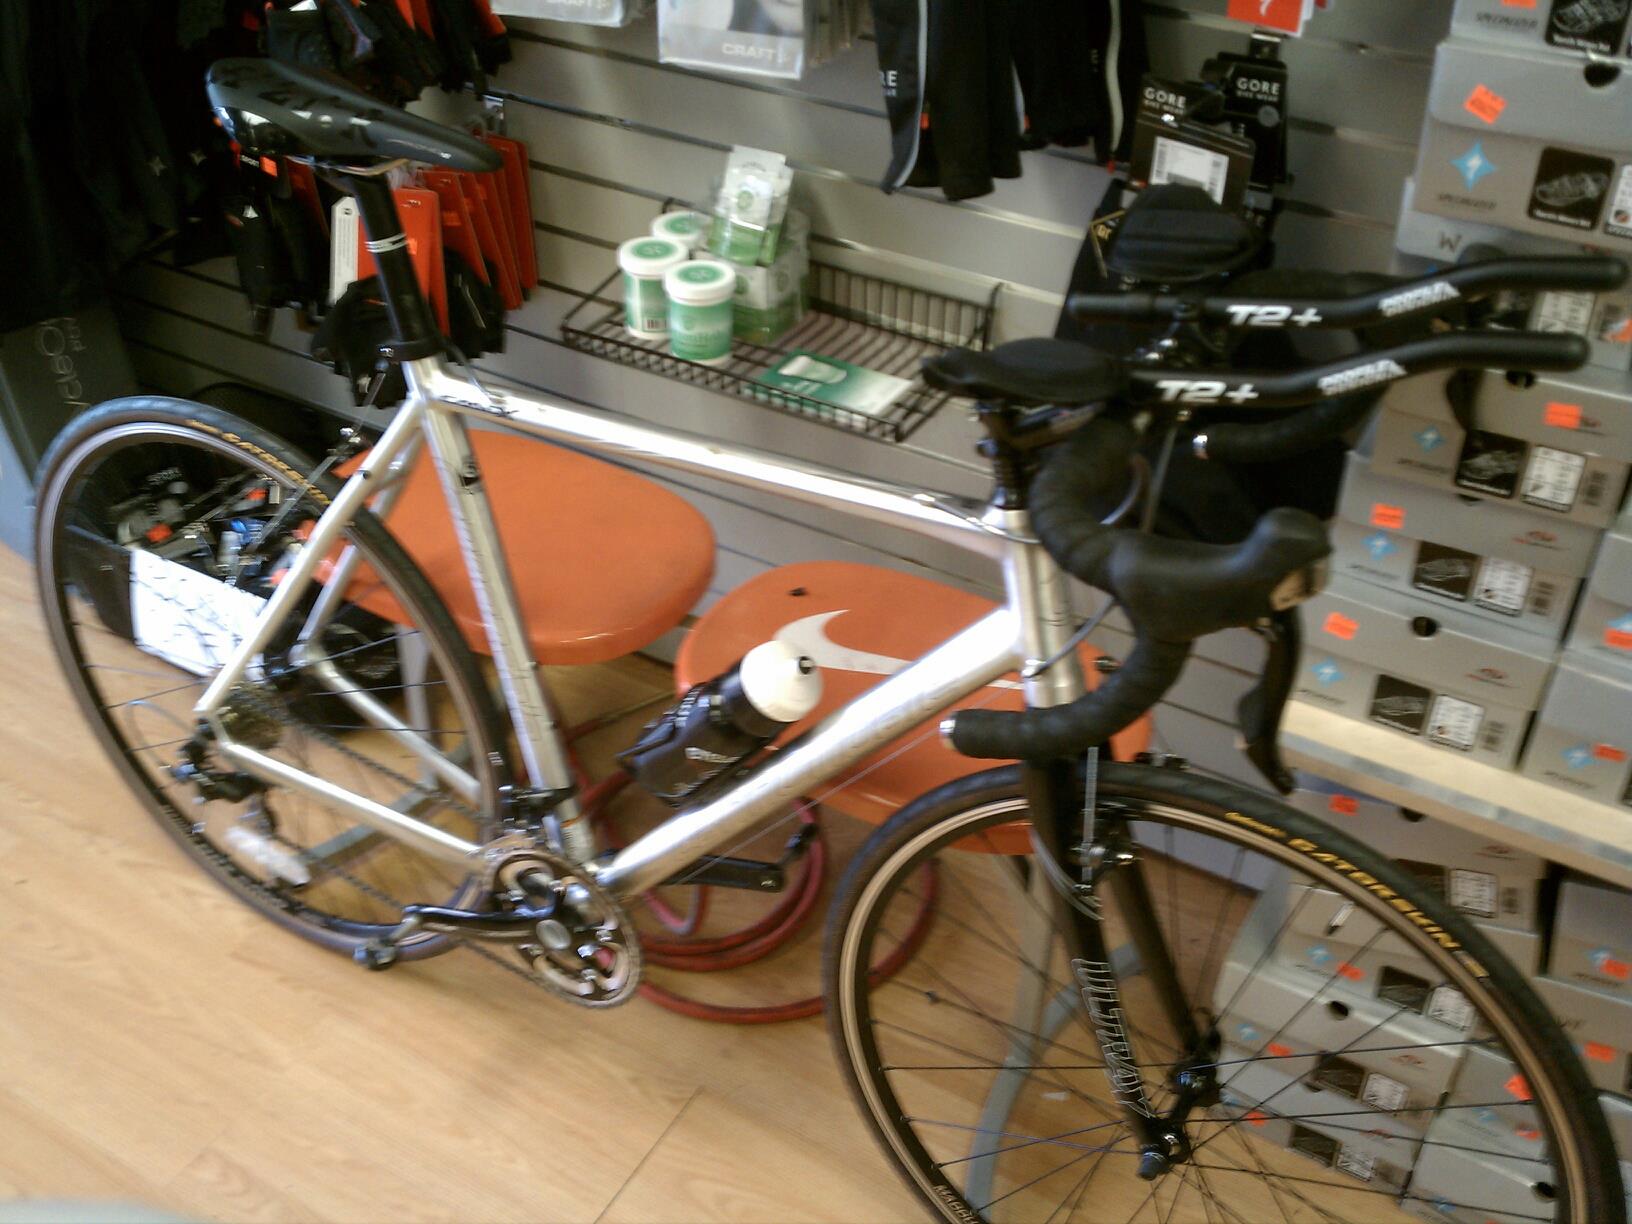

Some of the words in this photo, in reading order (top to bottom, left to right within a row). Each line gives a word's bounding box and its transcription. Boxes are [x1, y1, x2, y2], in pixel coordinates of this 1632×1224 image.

[722, 43, 776, 61] CRAFT
[1144, 86, 1187, 109] GORE
[1236, 77, 1281, 95] GORE
[1226, 304, 1323, 327] T2+
[1156, 379, 1260, 404] T2+
